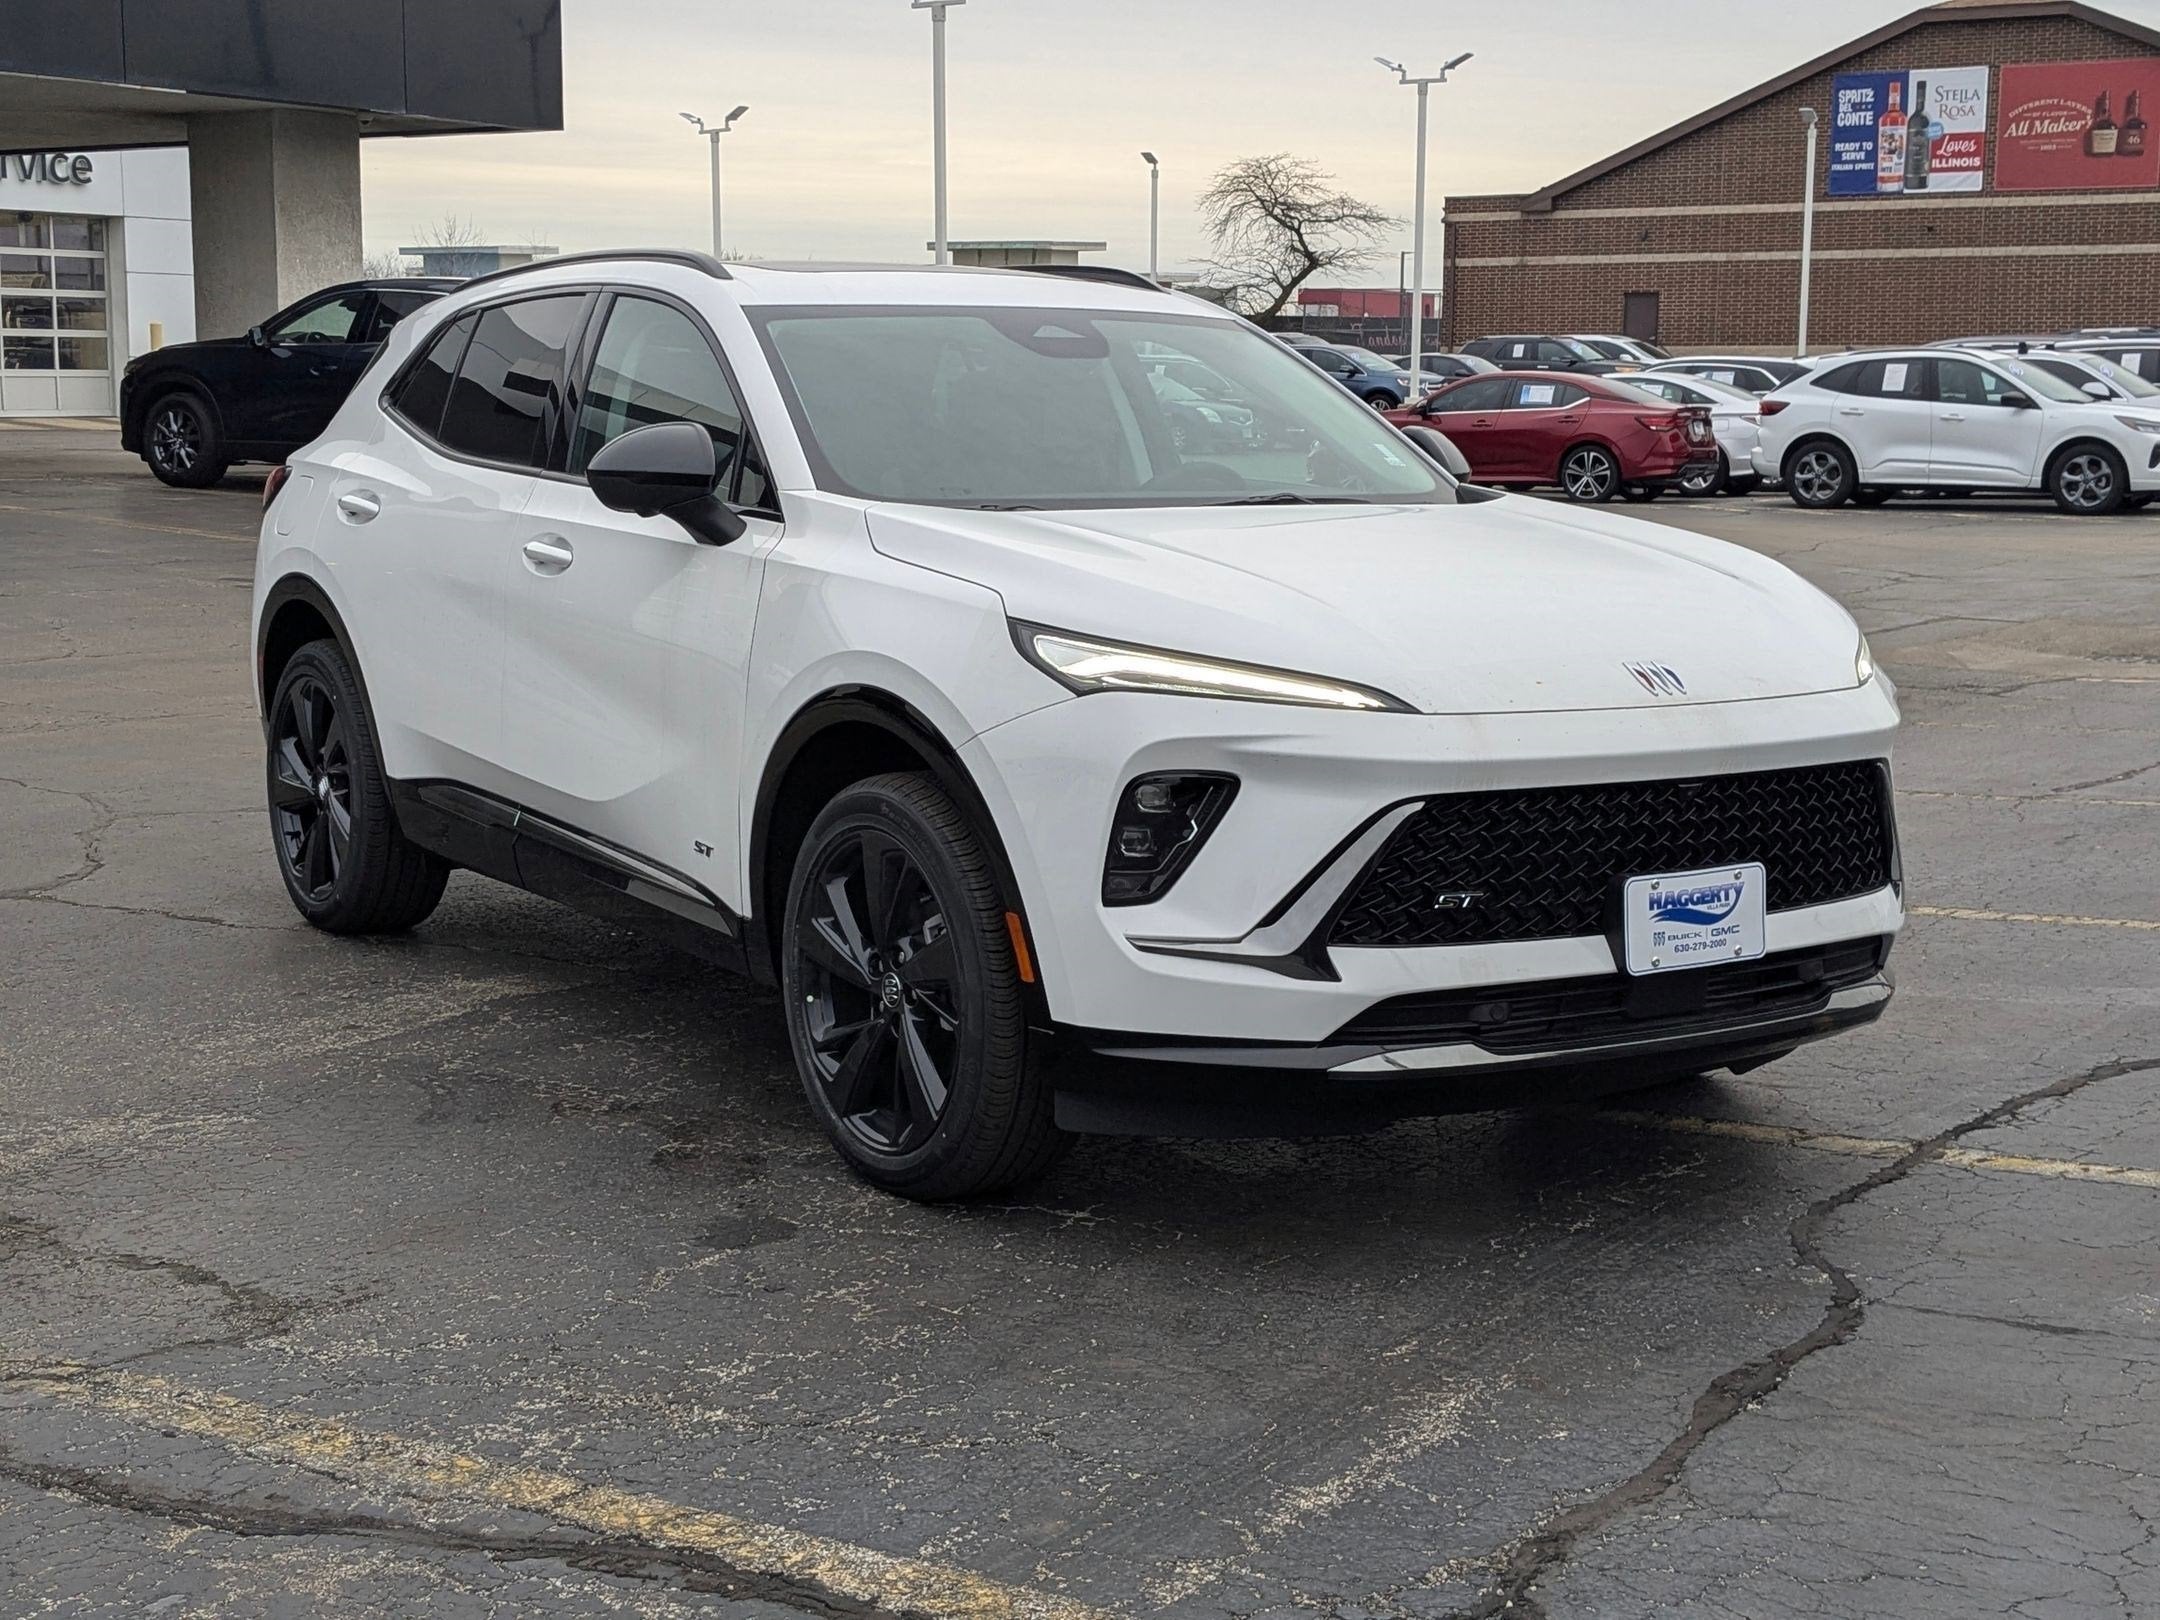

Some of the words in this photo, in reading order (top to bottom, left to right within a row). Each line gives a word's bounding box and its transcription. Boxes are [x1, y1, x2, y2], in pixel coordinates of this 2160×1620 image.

[1838, 87, 1875, 103] SPRITZ
[1934, 85, 1981, 103] STELLA
[1839, 103, 1853, 112] DEL
[1940, 103, 1976, 120] ROSA
[1837, 111, 1874, 127] CONTE
[2003, 119, 2030, 138] All
[1835, 142, 1861, 152] READY
[1861, 141, 1873, 151] TO
[1936, 135, 1977, 157] Loves
[2128, 135, 2141, 145] 46
[1841, 151, 1866, 161] SERVE
[1931, 156, 1981, 168] ILLINOIS
[693, 840, 714, 858] ST
[1434, 893, 1484, 909] ST
[1649, 881, 1745, 912] HAGGERTY
[1667, 931, 1702, 941] BUICK
[1711, 924, 1740, 937] GMC
[1674, 938, 1727, 953] 630-279-2000
